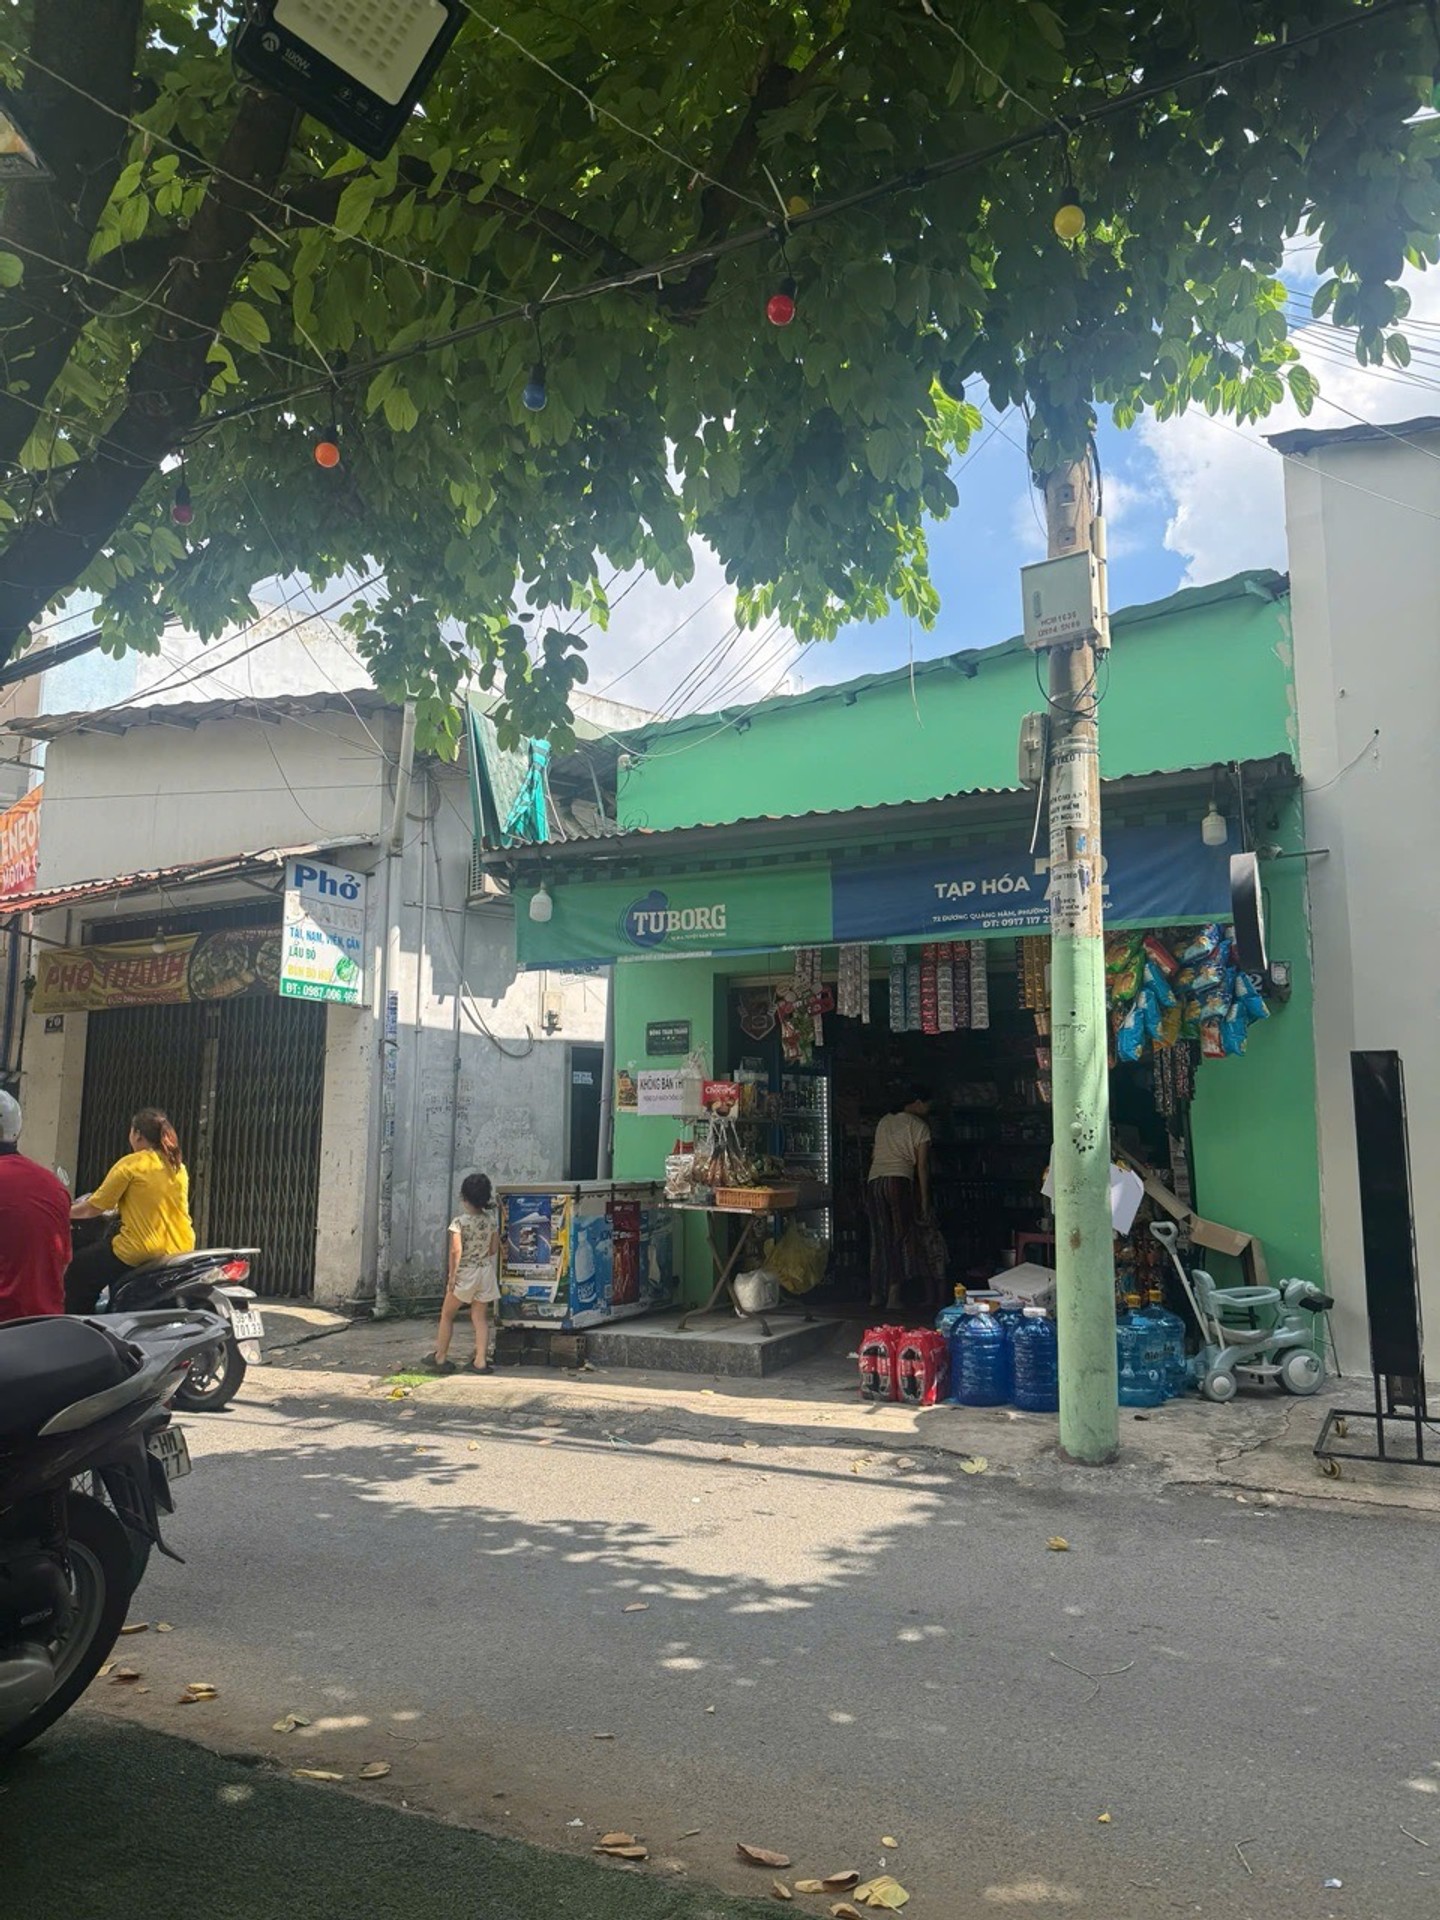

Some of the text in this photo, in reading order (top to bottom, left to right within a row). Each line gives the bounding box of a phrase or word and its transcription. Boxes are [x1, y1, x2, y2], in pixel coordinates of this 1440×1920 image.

[294, 864, 361, 900] Phở
[934, 882, 976, 901] TẠP
[982, 872, 1030, 896] HÓA
[633, 904, 726, 936] TUBORG
[1001, 918, 1024, 928] 0917
[1025, 916, 1040, 925] 117
[640, 1075, 660, 1090] KHÔNG
[661, 1076, 674, 1090] BÁN
